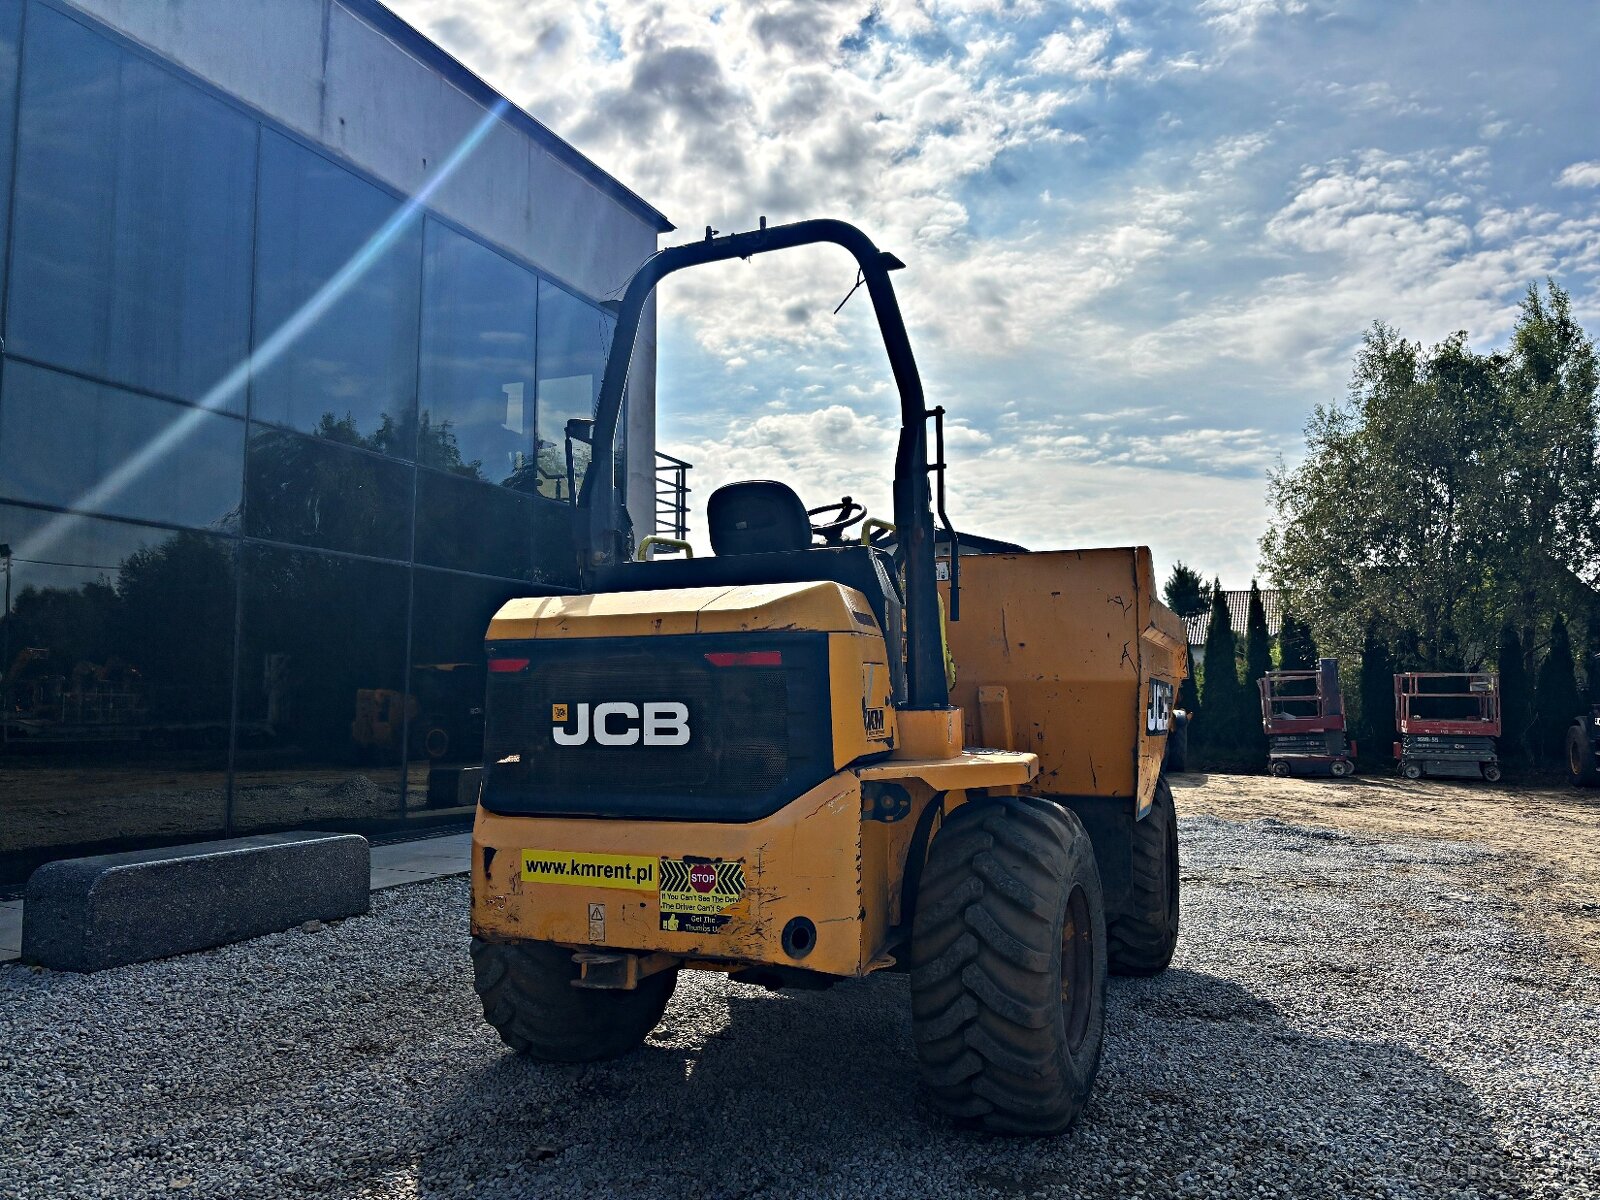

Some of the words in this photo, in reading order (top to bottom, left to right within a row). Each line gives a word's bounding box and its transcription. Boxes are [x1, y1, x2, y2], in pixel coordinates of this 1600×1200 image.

[552, 702, 691, 746] JCB
[525, 858, 653, 885] www.kmrent.pl
[691, 873, 715, 883] STOP
[668, 893, 679, 901] You
[680, 893, 697, 902] Can't
[698, 894, 711, 902] See
[711, 895, 724, 903] The
[662, 902, 674, 910] The
[675, 902, 696, 911] Driver
[697, 904, 715, 913] Can't
[703, 916, 716, 924] The
[685, 924, 711, 932] Thumbs
